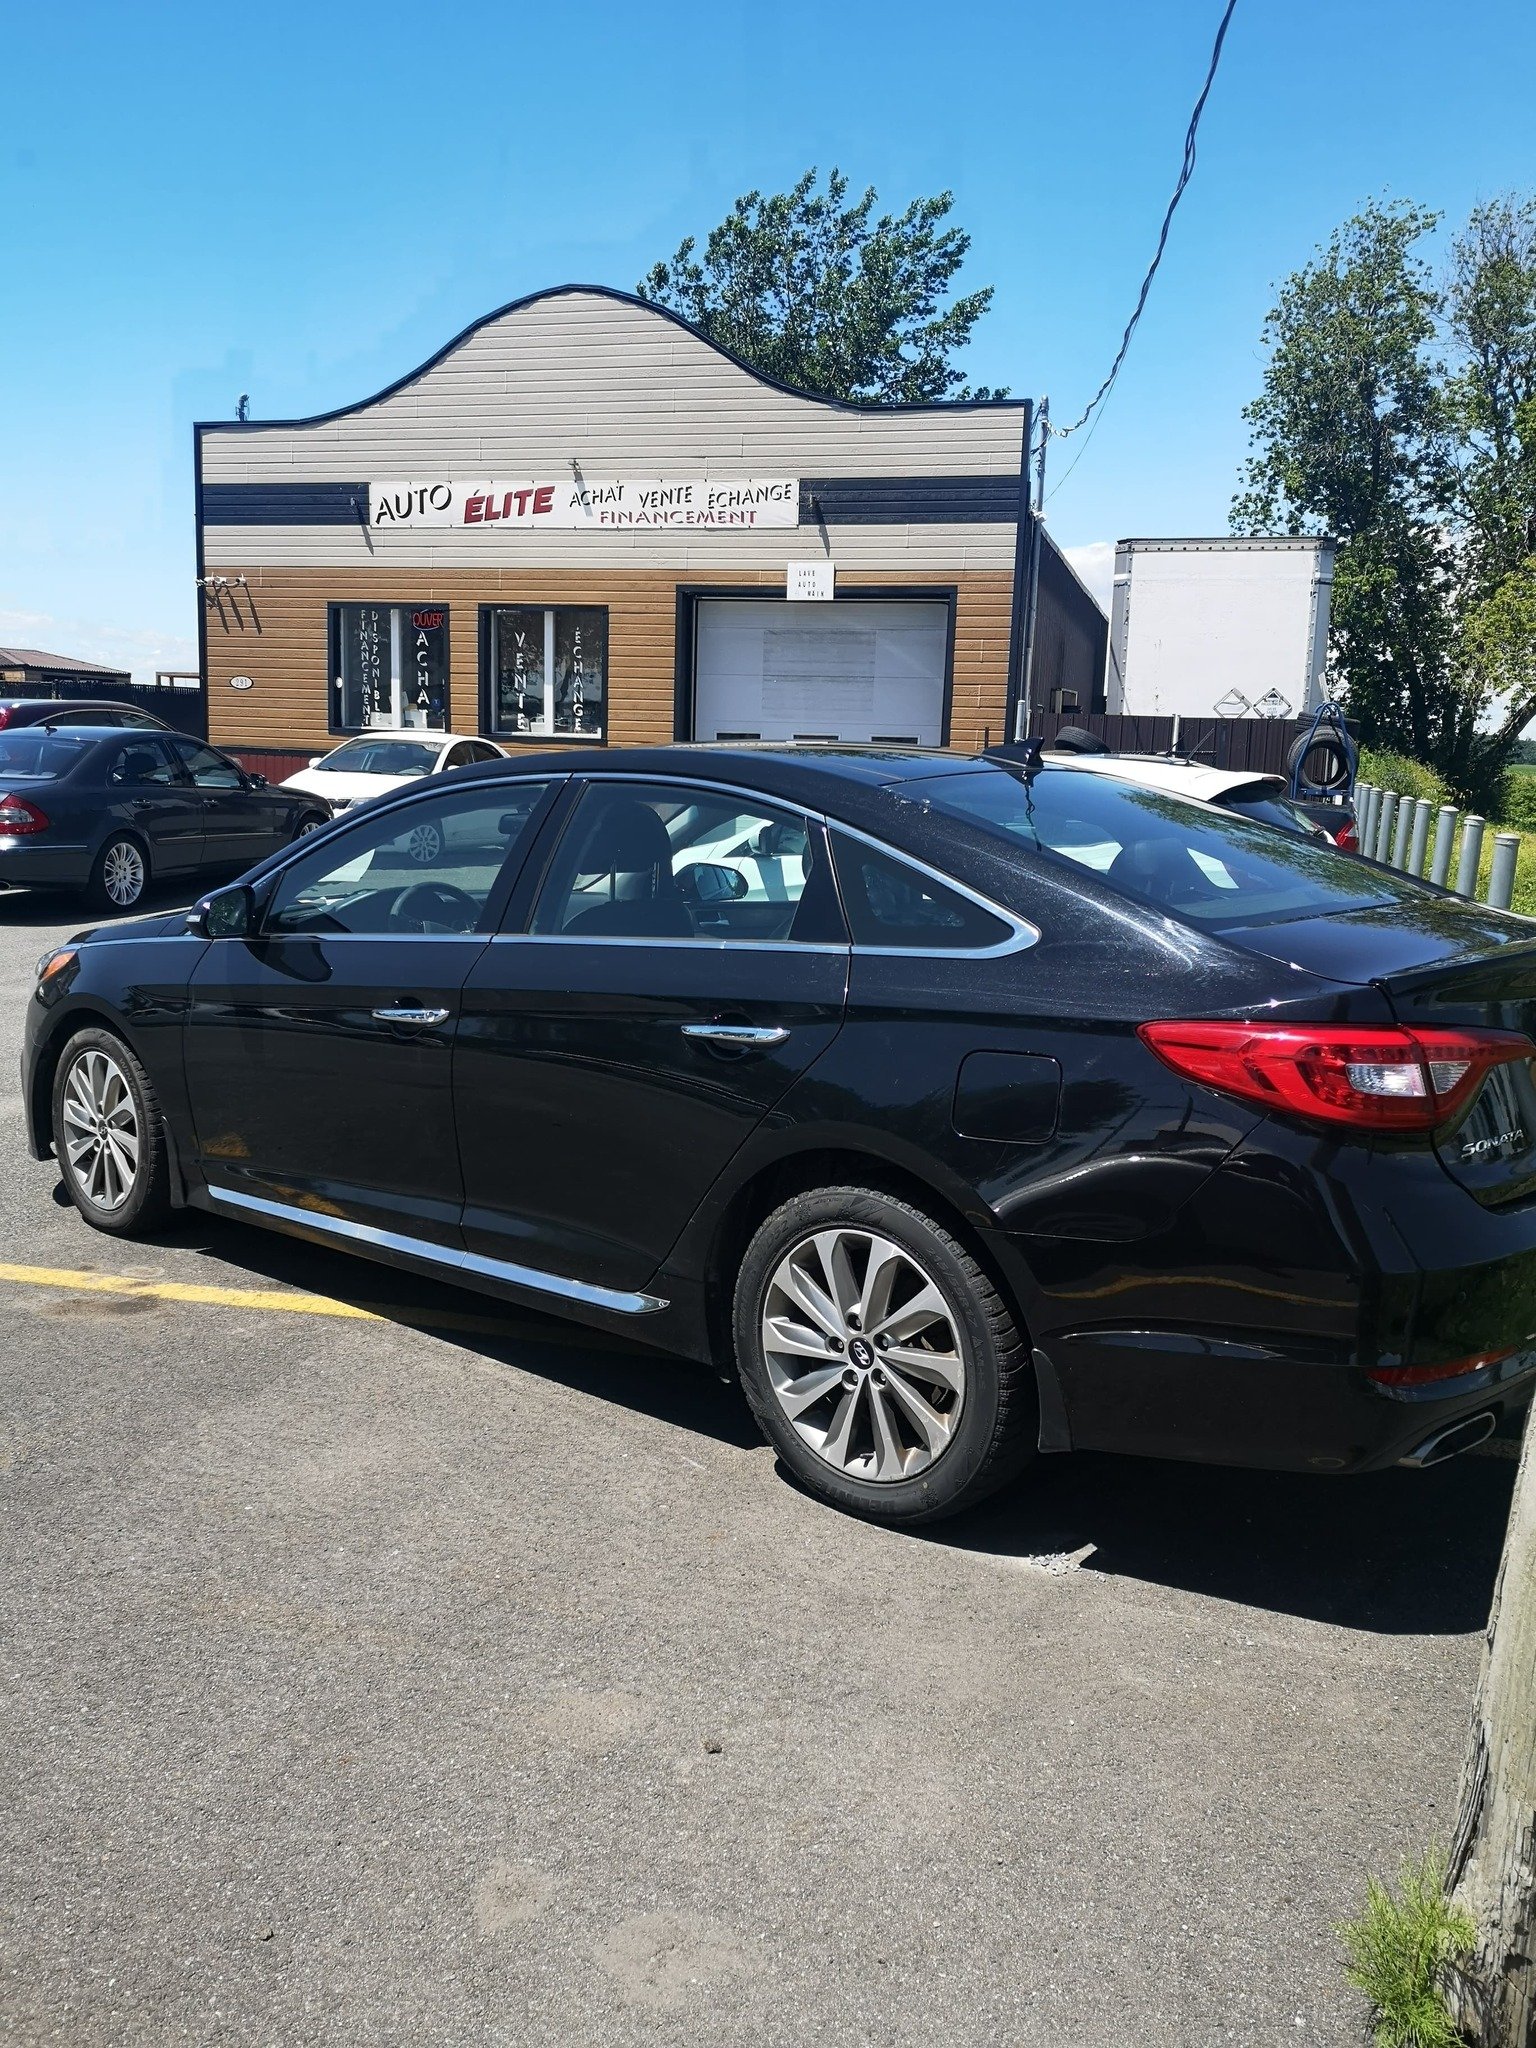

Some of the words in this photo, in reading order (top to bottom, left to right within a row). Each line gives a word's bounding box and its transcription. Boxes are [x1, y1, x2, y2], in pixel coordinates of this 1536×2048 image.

[375, 485, 452, 524] AUTO
[463, 486, 556, 524] ÉLITE
[569, 485, 625, 508] ACHAT
[638, 485, 693, 508] VENTE
[708, 483, 792, 509] ÉCHANGE
[600, 510, 758, 524] FINANCEMENT
[359, 609, 371, 726] FINANCEMENT
[370, 610, 381, 724] DISPONIBLE
[415, 630, 430, 728] ACHAT
[513, 631, 527, 731] VENTE
[572, 626, 584, 731] ÉCHANGE
[1460, 1129, 1525, 1159] SONATA
